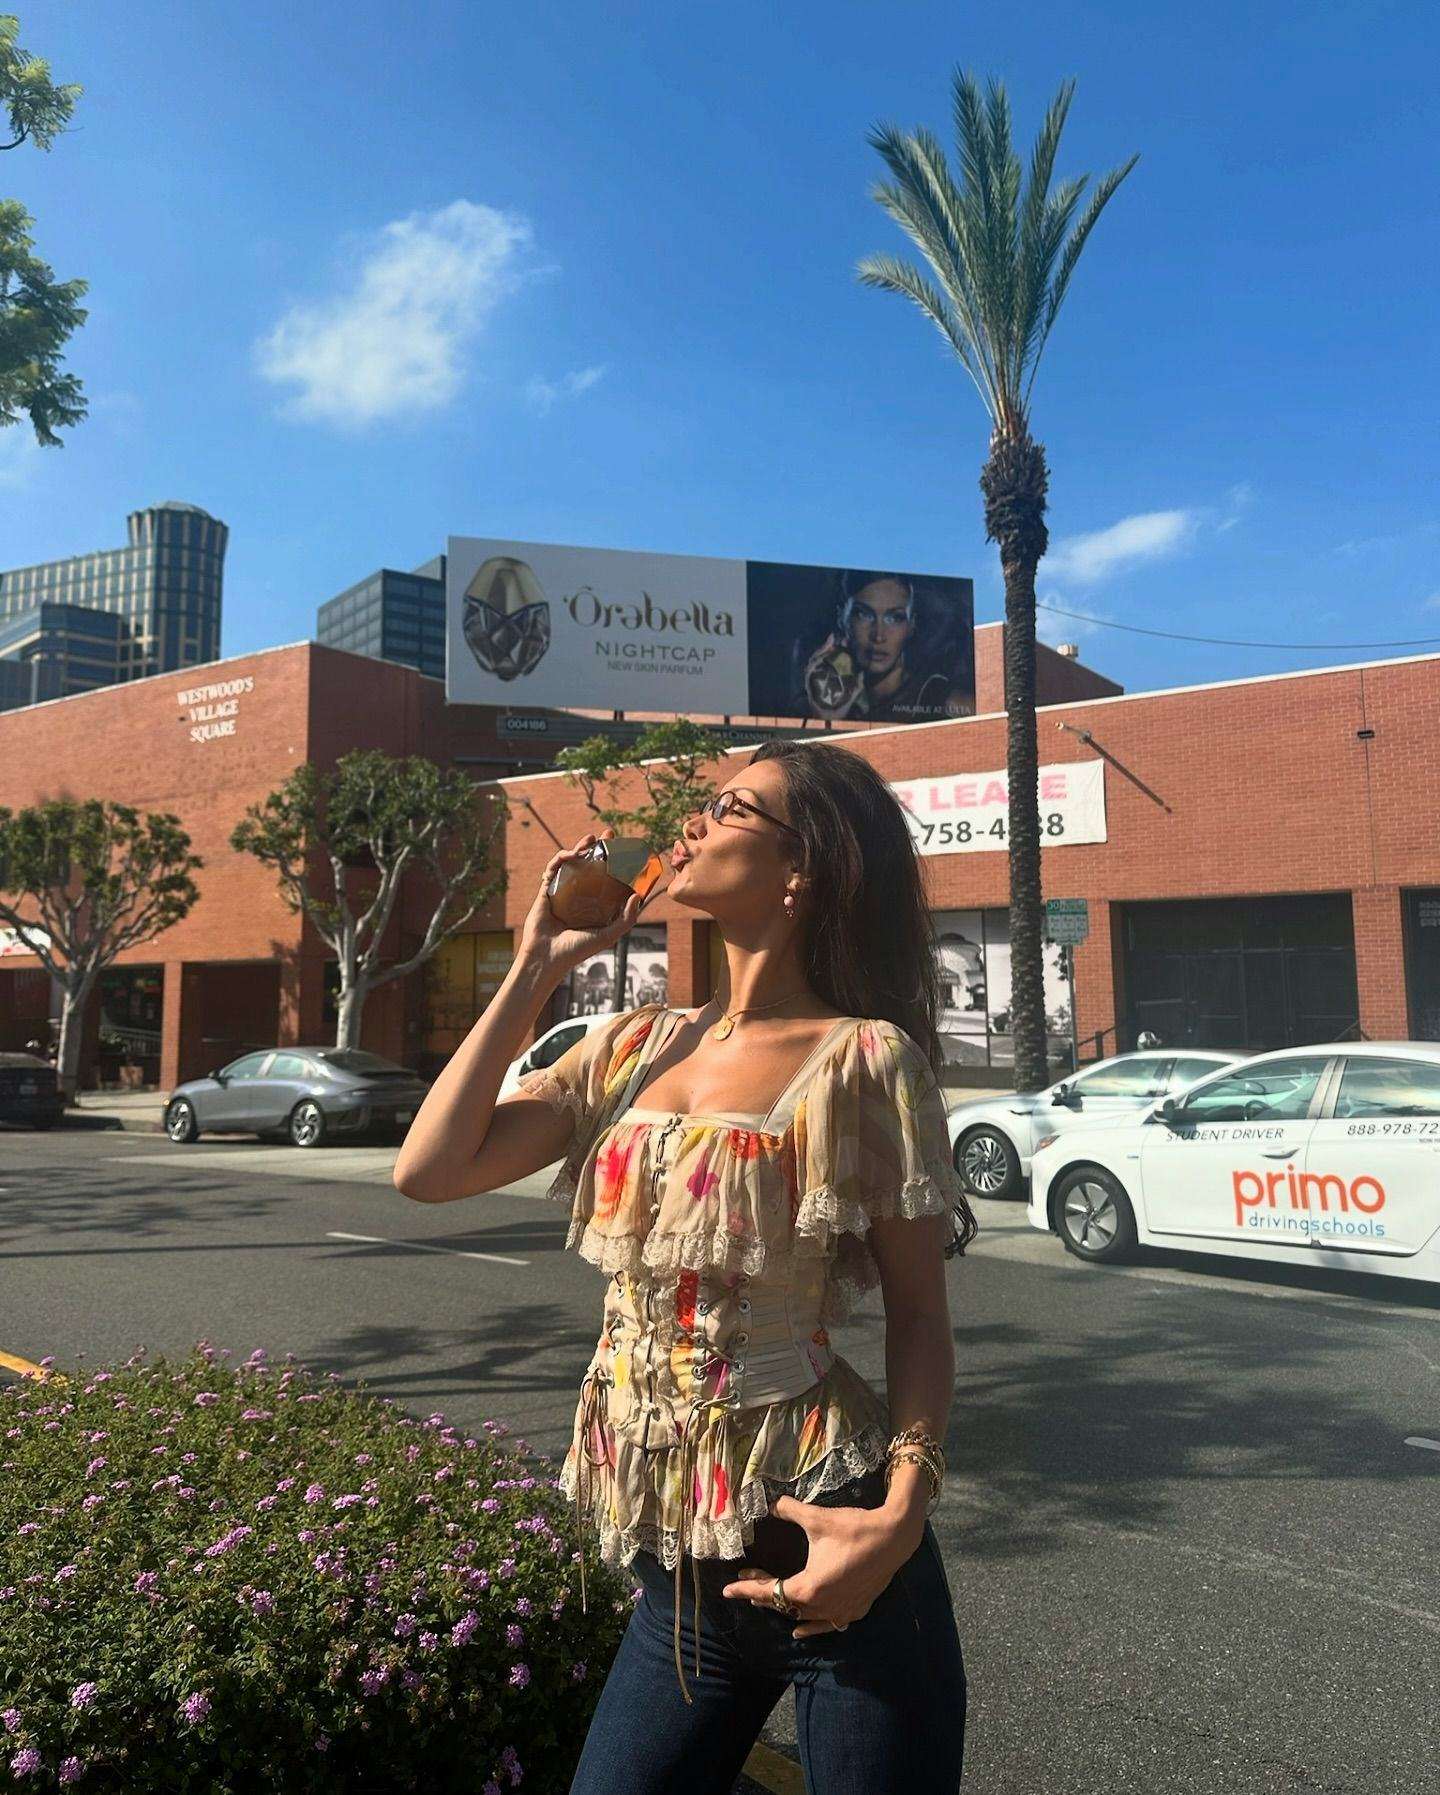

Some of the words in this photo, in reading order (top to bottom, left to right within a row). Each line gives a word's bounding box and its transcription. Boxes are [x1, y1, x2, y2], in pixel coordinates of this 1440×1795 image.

[595, 641, 716, 662] NIGHTCAP
[608, 661, 631, 671] NEW
[634, 662, 659, 673] SKIN
[660, 664, 703, 676] PARFUM
[190, 699, 239, 722] VILLAGE
[190, 719, 236, 743] SQUARE
[929, 773, 1067, 811] LEAE
[1167, 1129, 1229, 1142] STUDENT
[1232, 1128, 1284, 1140] DRIVER
[1232, 1163, 1386, 1226] primo
